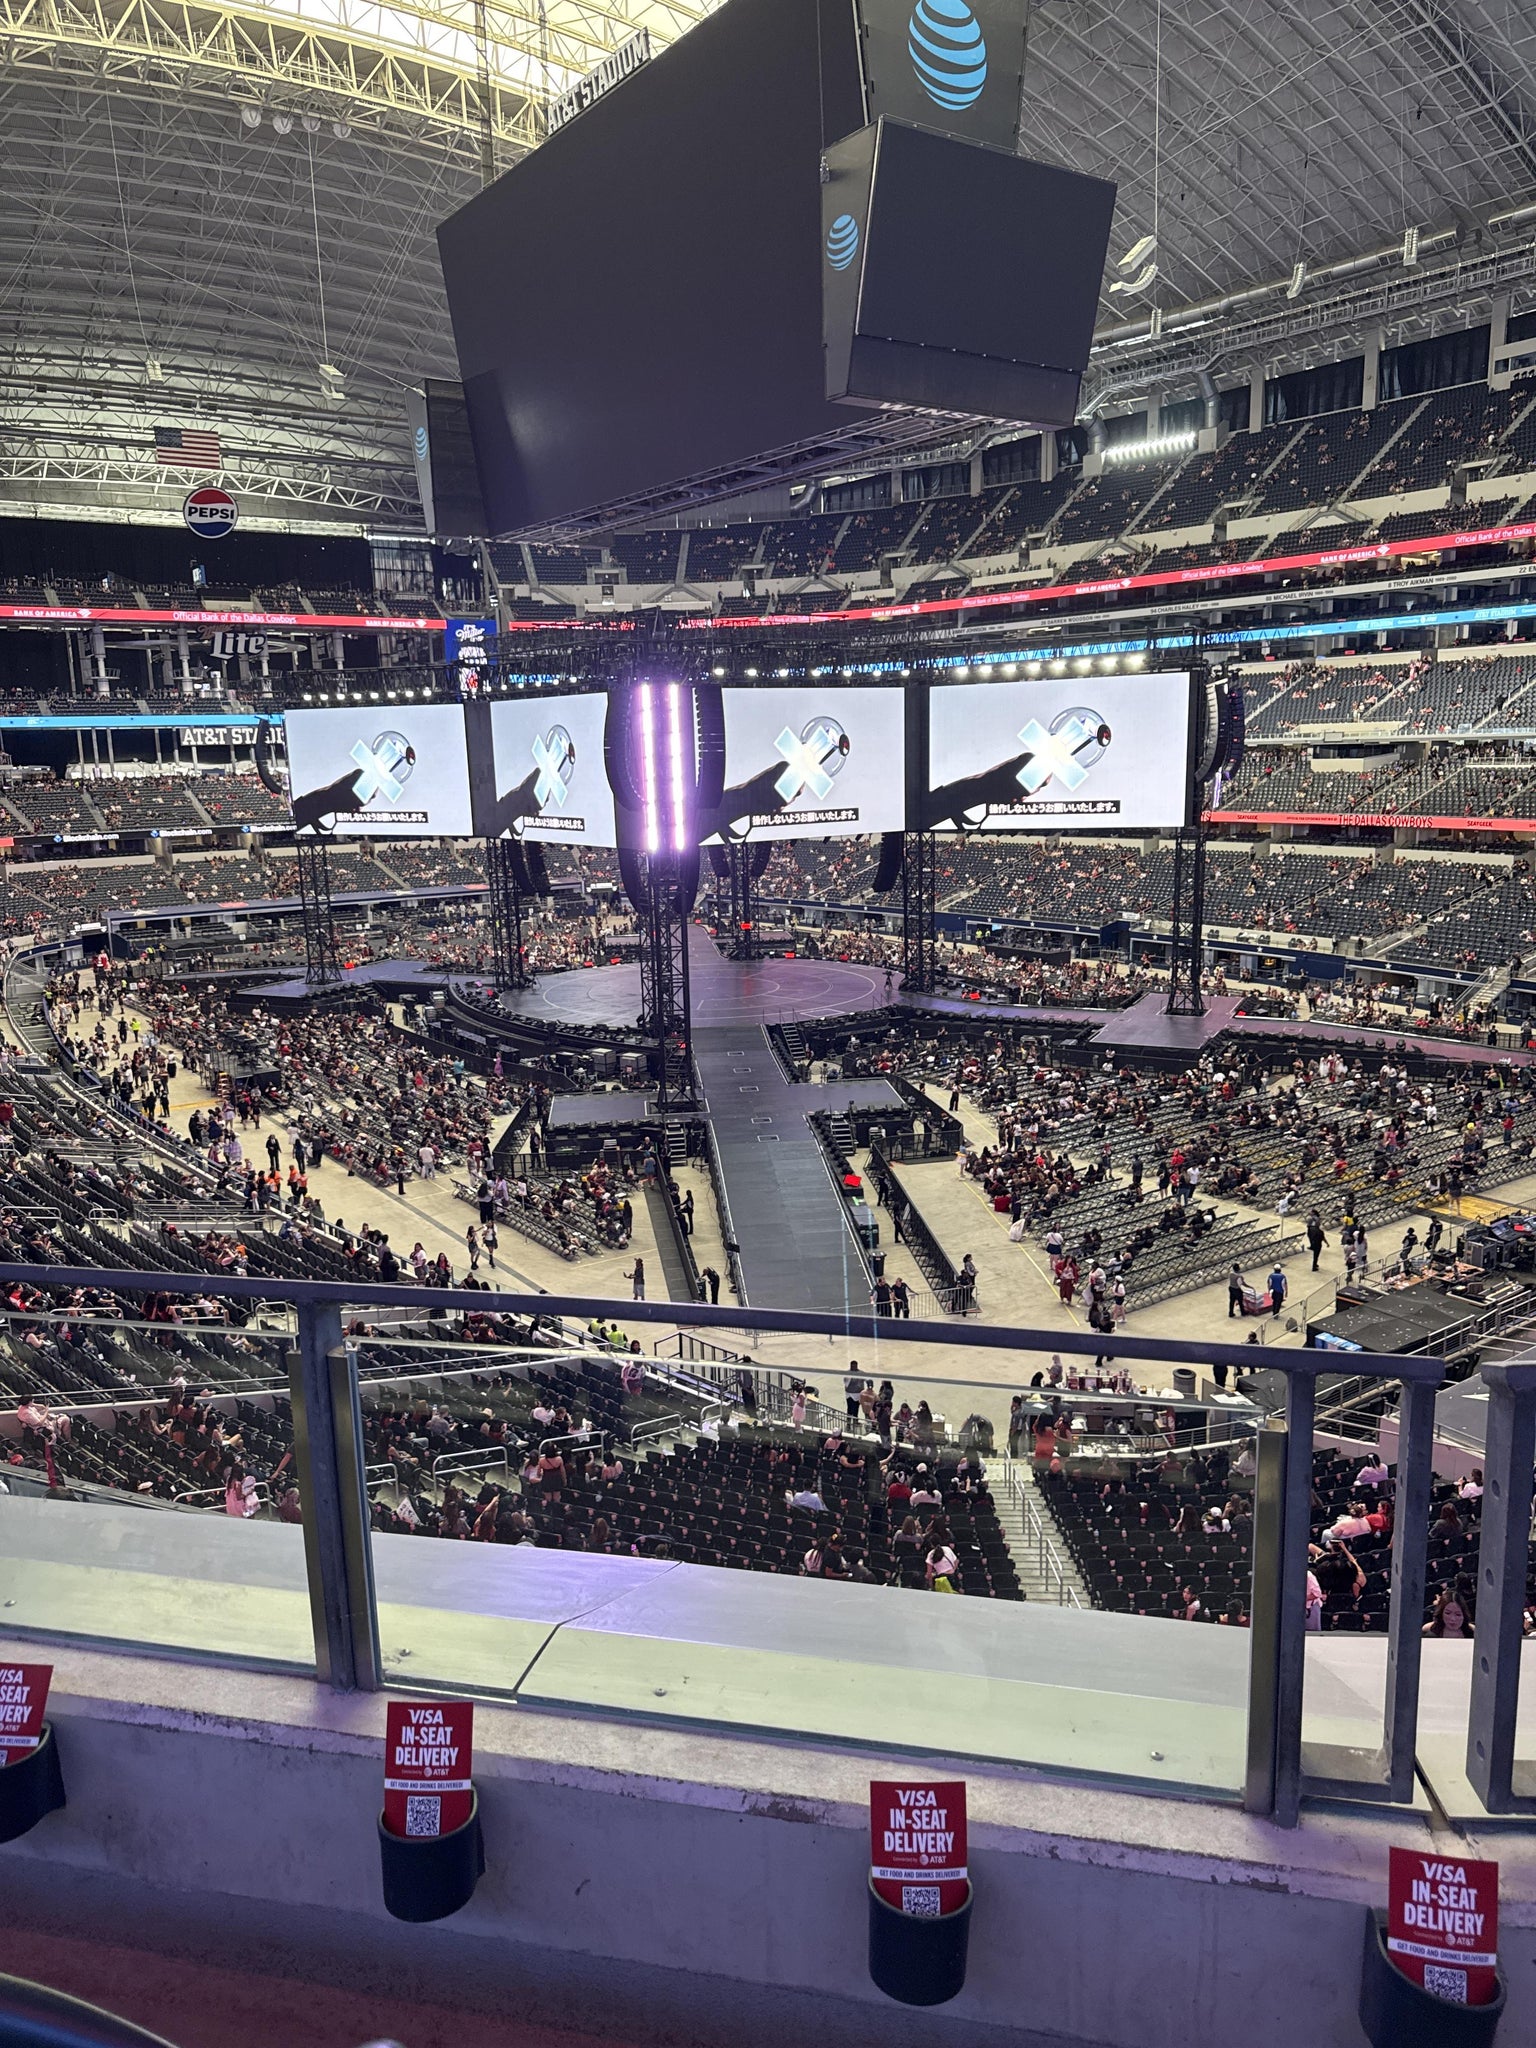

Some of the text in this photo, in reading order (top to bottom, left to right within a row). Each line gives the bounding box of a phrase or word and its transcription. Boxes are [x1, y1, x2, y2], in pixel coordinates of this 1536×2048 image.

[547, 28, 651, 136] AT&T STADIUM
[879, 402, 1032, 427] WINSTAR
[187, 506, 235, 520] PEPSI
[1455, 535, 1477, 544] Official
[1478, 532, 1495, 541] Bank
[1496, 531, 1502, 540] of
[1502, 530, 1513, 538] the
[1513, 527, 1531, 537] Dallas
[1338, 553, 1348, 562] OF
[1348, 550, 1376, 560] AMERICA
[1393, 580, 1409, 588] TROY
[1409, 577, 1433, 586] AIKMAN
[1273, 593, 1297, 601] MICHAEL
[1298, 591, 1314, 599] IRVIN
[1158, 605, 1181, 613] CHARLES
[1182, 603, 1200, 611] HALEY
[173, 612, 297, 624] Official Bank of the Dallas Cowboys
[210, 631, 266, 660] Lite
[182, 727, 227, 745] AT&T
[1339, 814, 1353, 825] THE
[1354, 815, 1387, 826] DALLAS
[1388, 815, 1433, 828] COWBOYS
[1467, 820, 1493, 828] SEATGEEK
[408, 1709, 443, 1724] VISA
[5, 1724, 20, 1732] AT&T
[401, 1725, 453, 1746] IN-SEAT
[395, 1746, 459, 1766] DELIVERY
[433, 1768, 449, 1776] AT&T
[895, 1789, 937, 1807] VISA
[890, 1808, 947, 1830] IN-SEAT
[884, 1831, 954, 1853] DELIVERY
[930, 1855, 947, 1864] AT&T
[880, 1869, 889, 1877] GET
[904, 1870, 915, 1878] AND
[915, 1871, 934, 1879] DRINKS
[1419, 1860, 1467, 1885] VISA
[1412, 1879, 1478, 1911] IN-SEAT
[1404, 1902, 1484, 1936] DELIVERY
[1456, 1936, 1475, 1946] AT&T
[1397, 1941, 1408, 1950] GET
[1409, 1944, 1426, 1955] FOOD
[1426, 1947, 1439, 1958] AND
[1440, 1950, 1462, 1961] DRINKS
